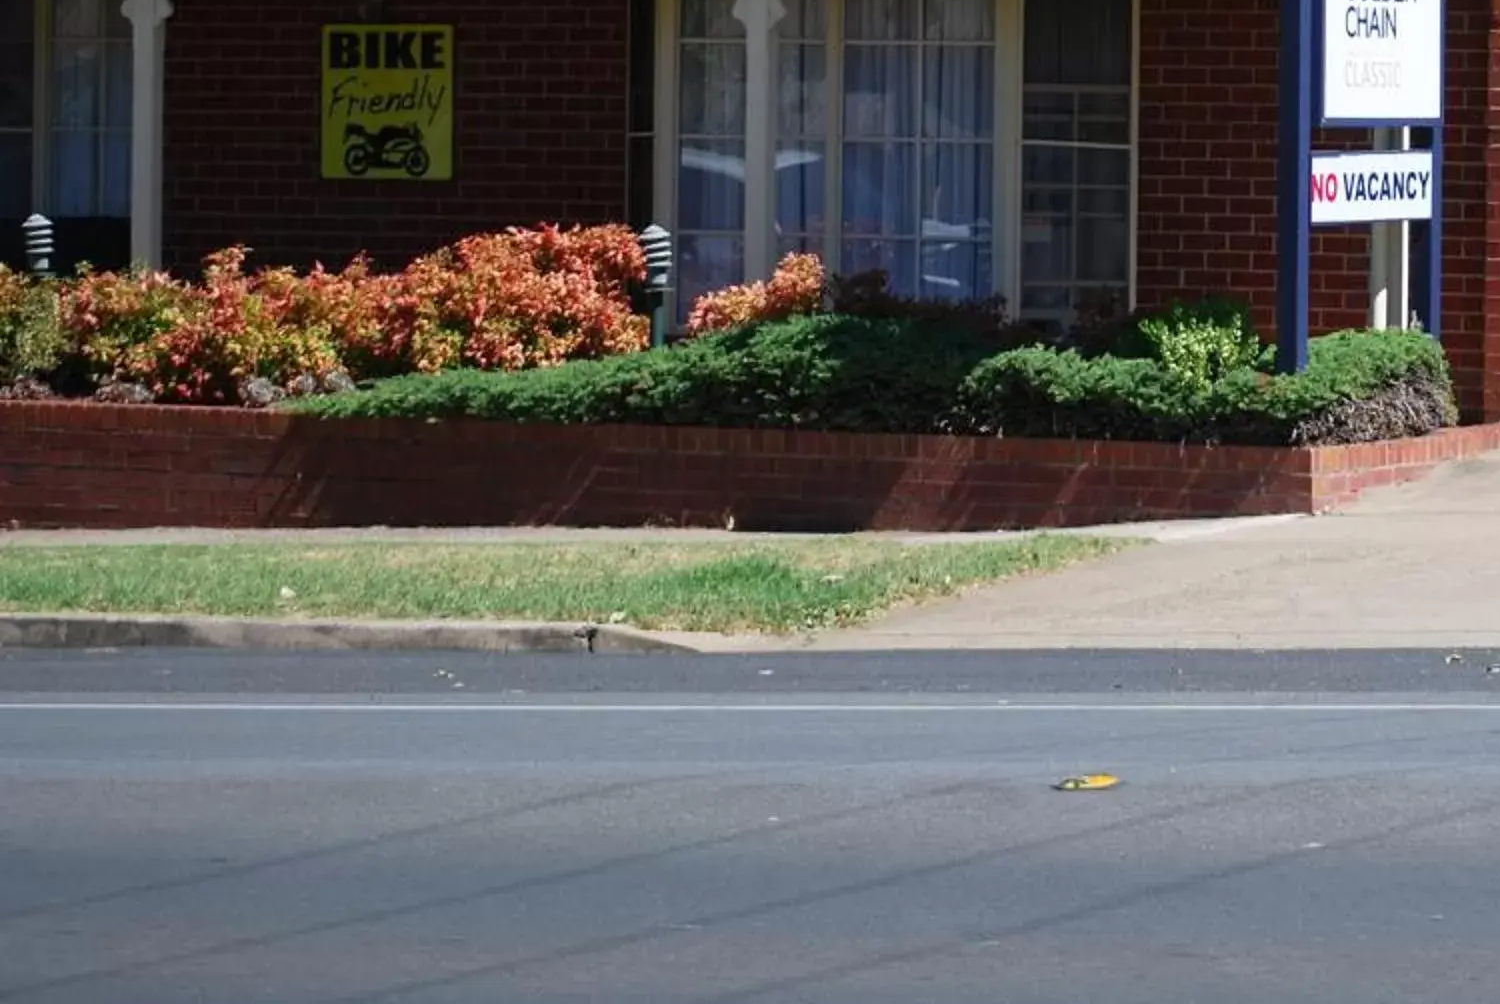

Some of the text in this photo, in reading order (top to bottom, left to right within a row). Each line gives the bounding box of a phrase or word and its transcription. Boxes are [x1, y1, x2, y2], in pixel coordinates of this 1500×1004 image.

[1345, 5, 1397, 39] CHAIN
[329, 31, 446, 70] BIKE
[1345, 60, 1401, 88] CLASSIC
[328, 73, 446, 127] Friendly
[1311, 170, 1430, 203] NO VACANCY
